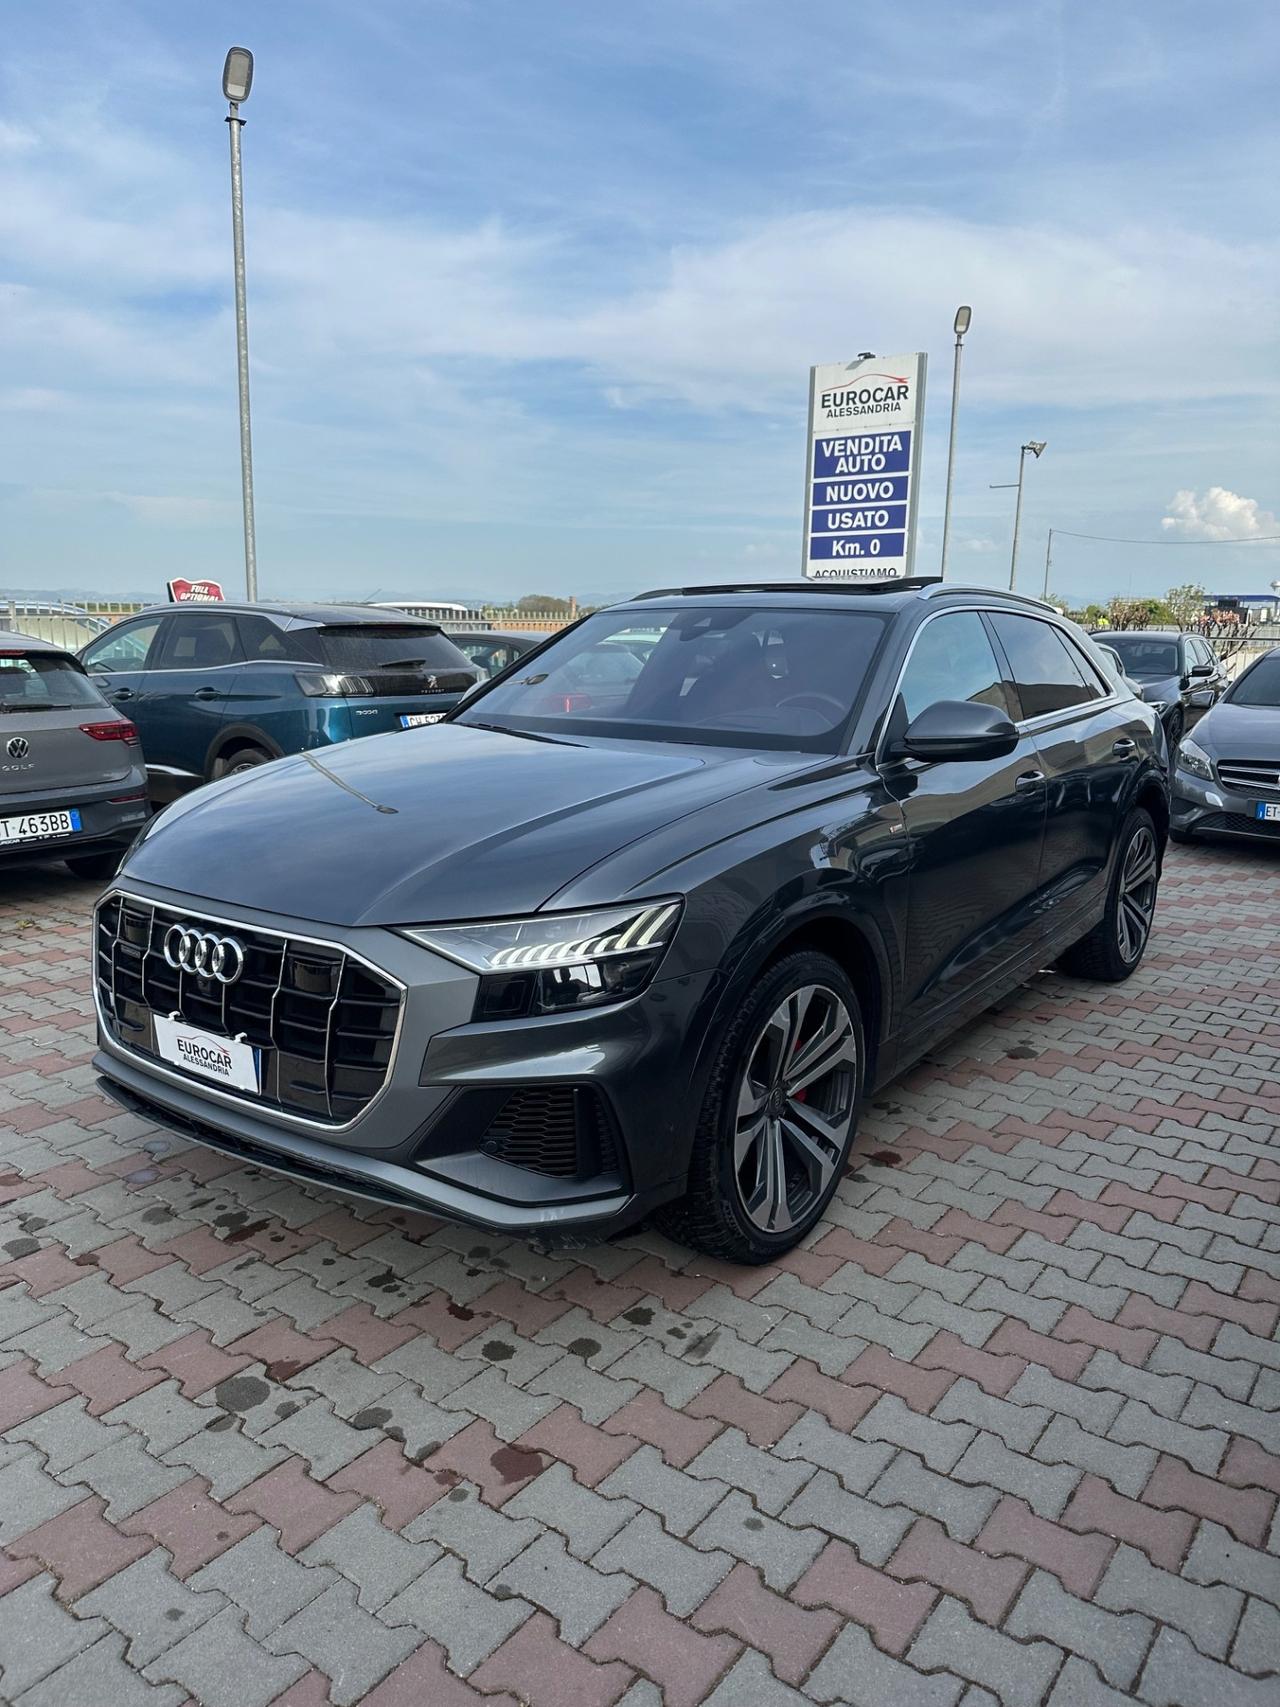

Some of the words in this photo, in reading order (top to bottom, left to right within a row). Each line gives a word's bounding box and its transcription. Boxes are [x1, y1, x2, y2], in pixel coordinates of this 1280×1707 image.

[821, 384, 909, 409] EUROCAR
[826, 402, 902, 418] ALESSANDRIA
[822, 434, 903, 458] VENDITA
[835, 453, 886, 474] AUTO
[826, 481, 894, 502] NUOVO
[827, 509, 889, 530] USATO
[832, 540, 865, 556] Km.
[870, 538, 881, 555] 0
[190, 585, 209, 594] FULL
[2, 763, 35, 772] GOLF
[18, 813, 70, 836] 463BB
[177, 1038, 233, 1070] EUROCAR
[183, 1053, 230, 1077] ALESSANDRIA
